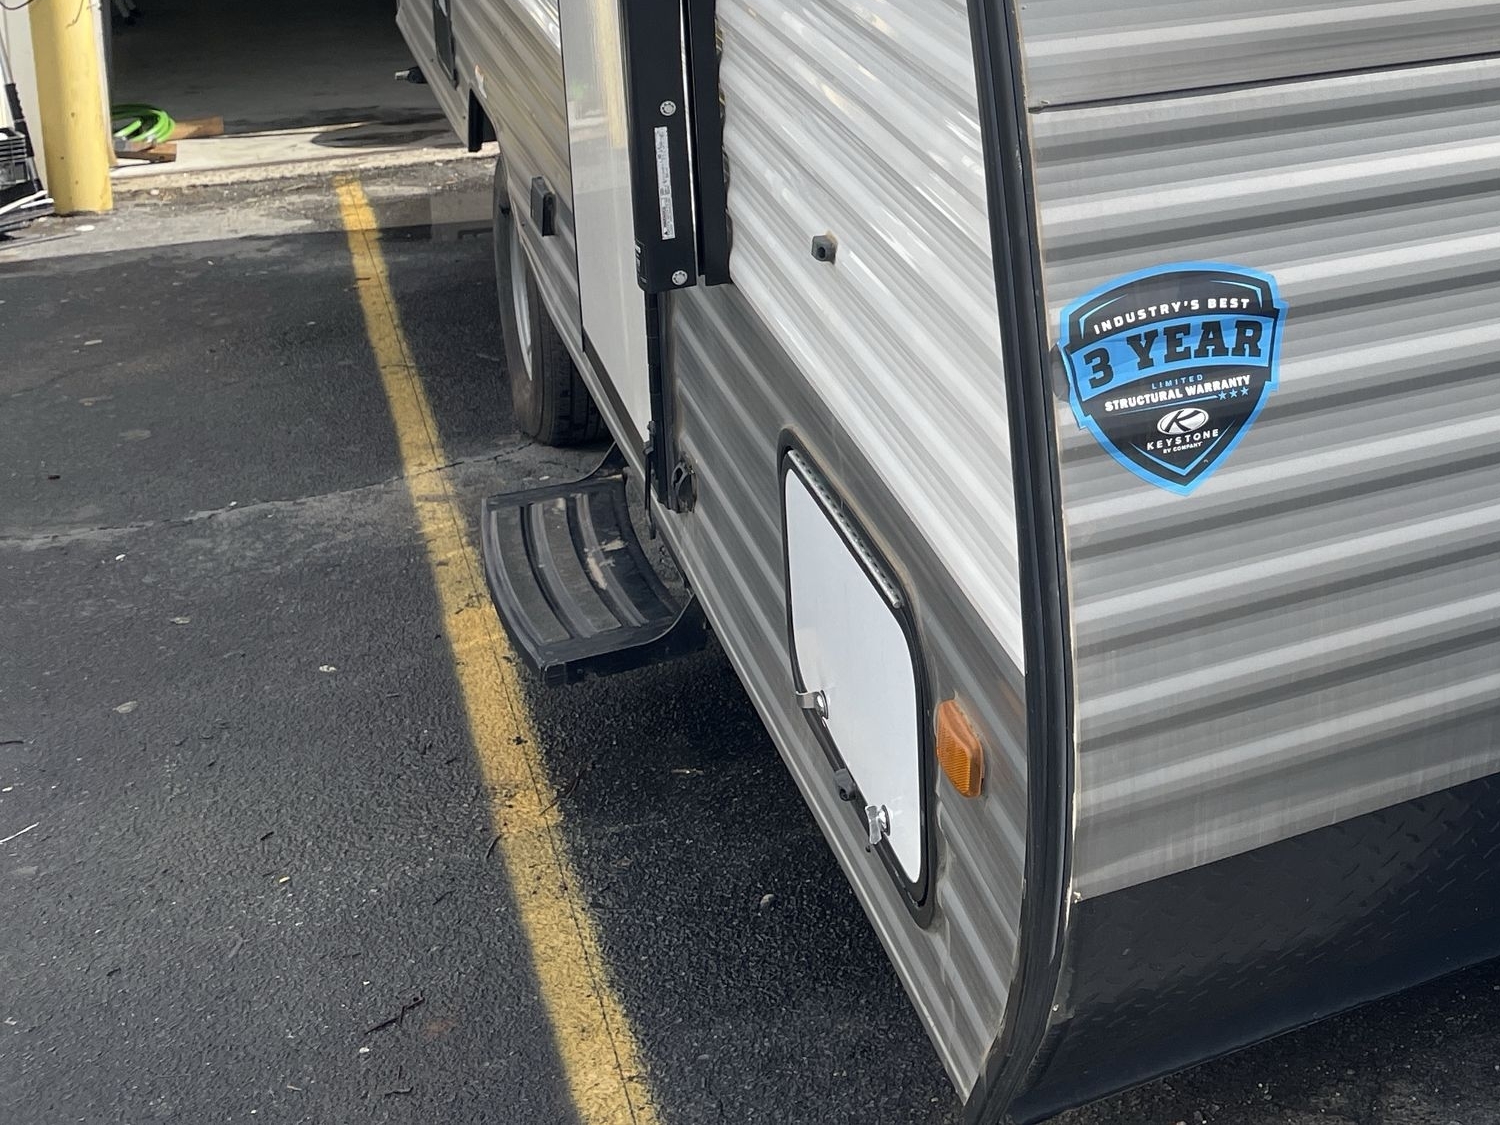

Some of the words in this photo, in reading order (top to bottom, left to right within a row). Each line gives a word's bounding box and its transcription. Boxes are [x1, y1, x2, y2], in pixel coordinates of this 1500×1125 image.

[1094, 299, 1200, 334] INDUSTRY'S
[1208, 298, 1250, 310] BEST
[1083, 347, 1114, 390] 3
[1126, 320, 1263, 371] YEAR
[1104, 387, 1183, 412] STRUCTURAL
[1186, 374, 1251, 397] WARRANTY
[1151, 373, 1204, 390] LIMITED
[1146, 428, 1219, 451] KEYSTONE
[1173, 441, 1203, 452] COMPANY
